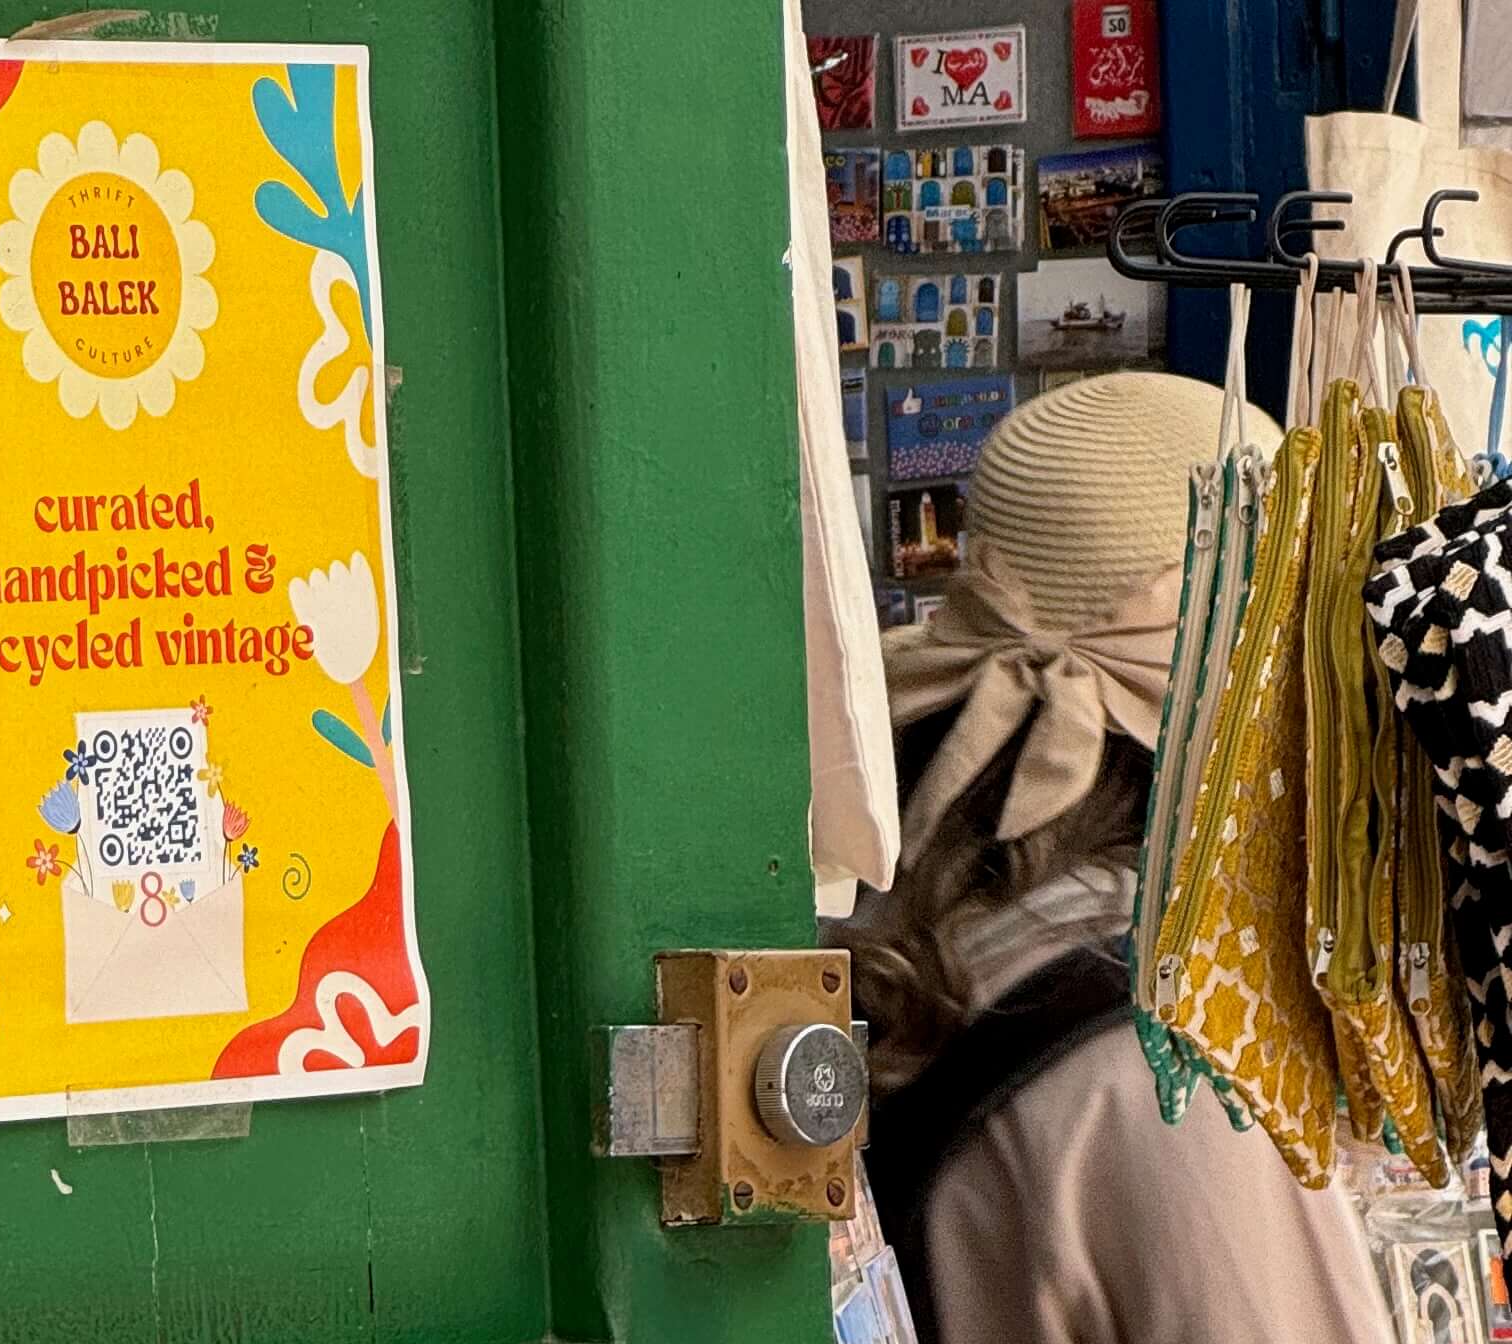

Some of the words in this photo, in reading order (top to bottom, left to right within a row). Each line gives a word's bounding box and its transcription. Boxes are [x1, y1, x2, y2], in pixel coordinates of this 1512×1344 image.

[932, 49, 946, 74] I
[941, 81, 991, 107] MA
[68, 186, 135, 208] THRIFT
[69, 224, 140, 259] BALI
[58, 280, 160, 316] BALEK
[75, 336, 153, 367] CULTURE
[34, 478, 216, 536] curated,
[243, 543, 276, 594] &
[157, 613, 315, 676] vintage
